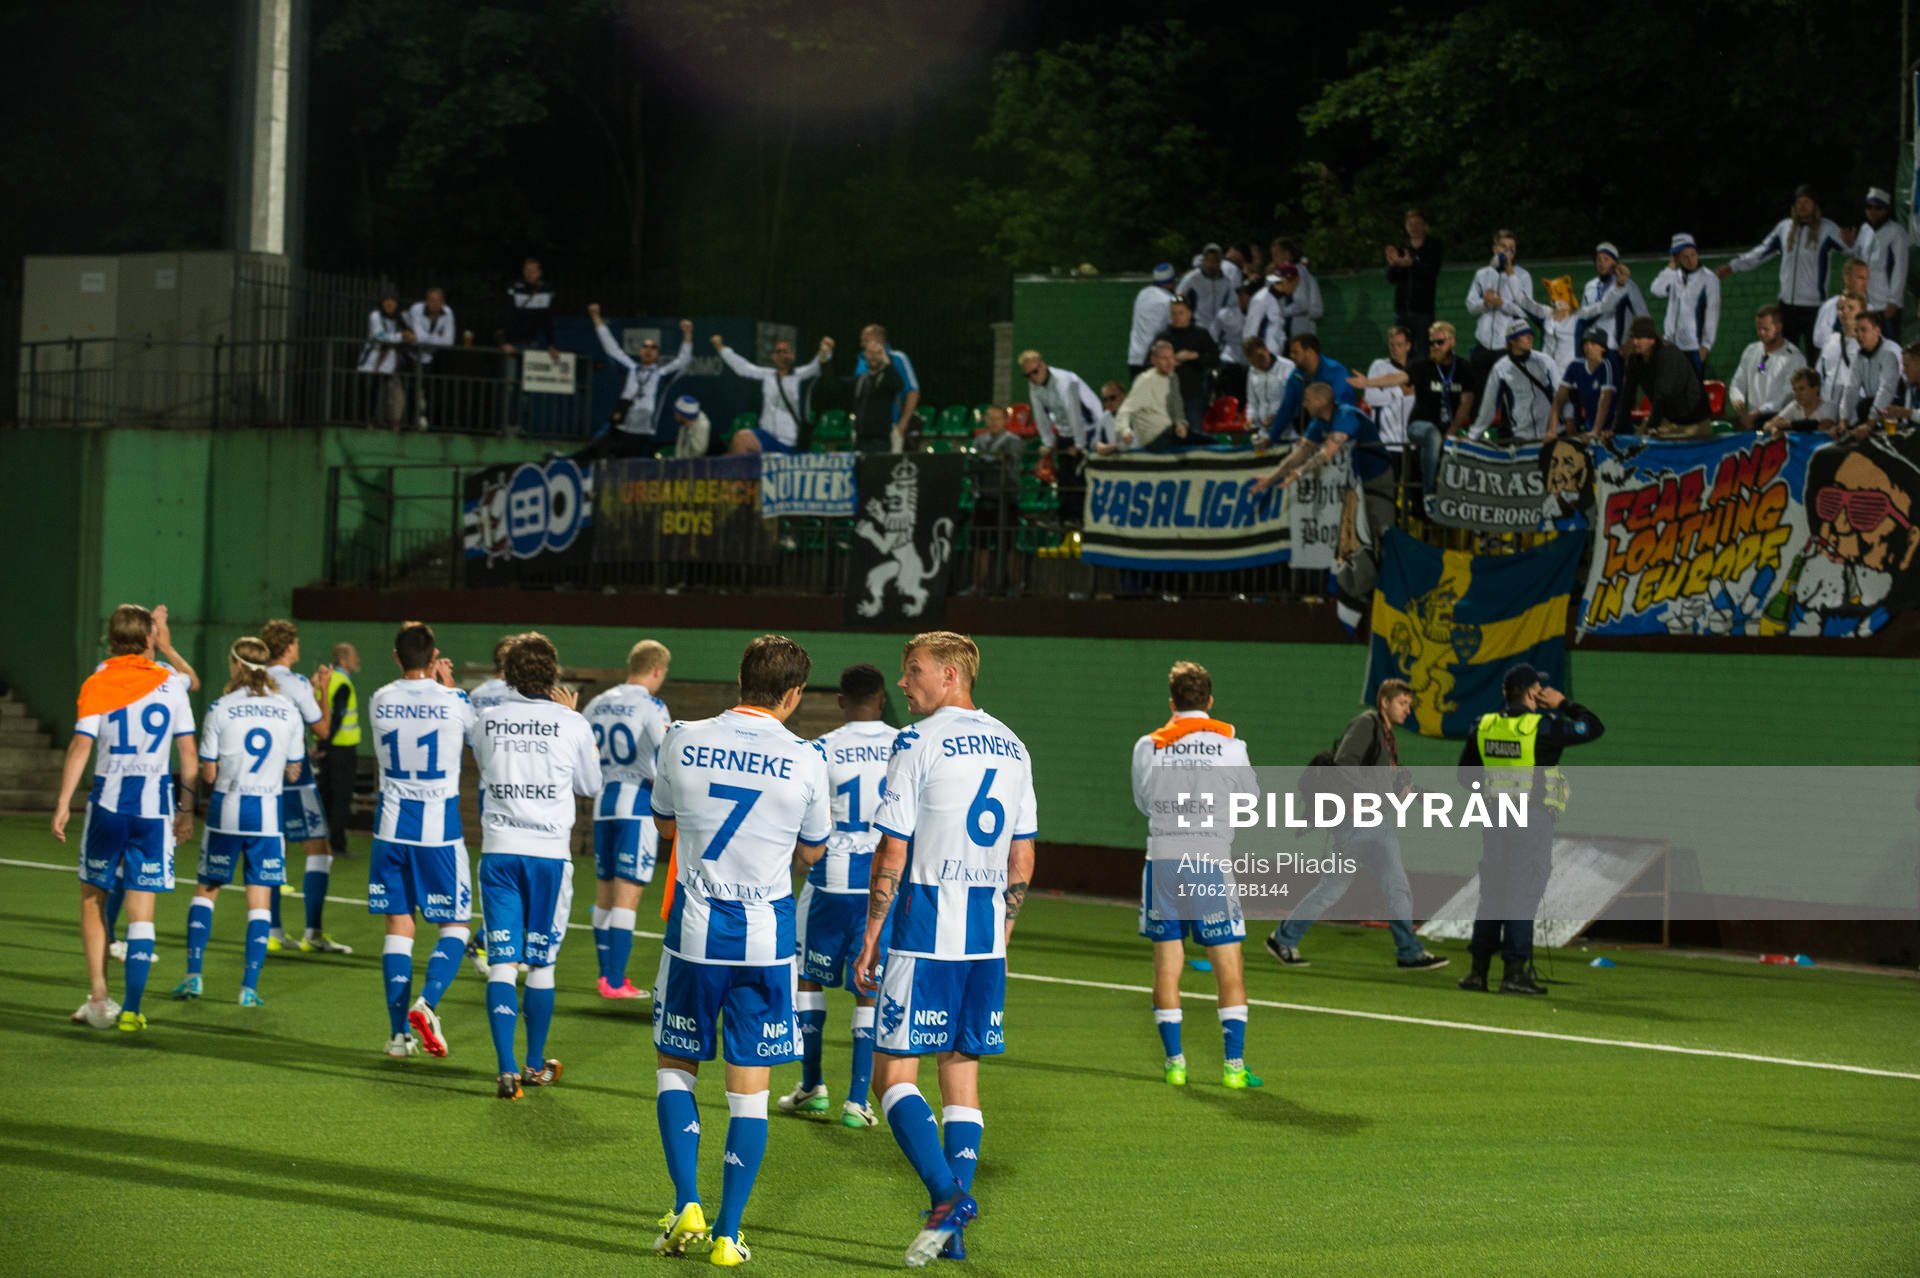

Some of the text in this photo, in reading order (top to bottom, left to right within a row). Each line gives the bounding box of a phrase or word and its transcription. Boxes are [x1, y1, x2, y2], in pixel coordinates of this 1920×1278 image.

[762, 470, 853, 503] NUTTERS
[1446, 463, 1544, 497] ULTRAS
[1605, 439, 1788, 537] FEAR AND
[1440, 496, 1541, 526] GÖTEBORG
[662, 510, 714, 536] BOYS
[1604, 482, 1788, 578] LOATHING
[1588, 526, 1791, 626] IN EUROPE
[228, 705, 289, 721] SERNEKE
[376, 704, 449, 719] SERNEKE
[108, 703, 171, 754] 19
[485, 719, 560, 738] Prioritet
[244, 727, 272, 774] 9
[381, 728, 446, 780] 11
[493, 736, 549, 754] Finans
[835, 746, 890, 764] SERNE
[942, 734, 1022, 762] SERNEKE
[681, 745, 794, 780] SERNEKE
[491, 783, 557, 799] SERNEKE
[967, 768, 1005, 848] 6
[701, 782, 763, 861] 7
[427, 894, 453, 905] NRC
[424, 906, 455, 919] Group
[1203, 911, 1226, 925] NRC
[808, 950, 832, 967] NRC
[805, 963, 835, 982] Group
[666, 1012, 697, 1032] NRC
[914, 1010, 949, 1026] NRC
[662, 1030, 701, 1053] Group
[757, 1039, 793, 1057] Group
[910, 1029, 948, 1047] Group
